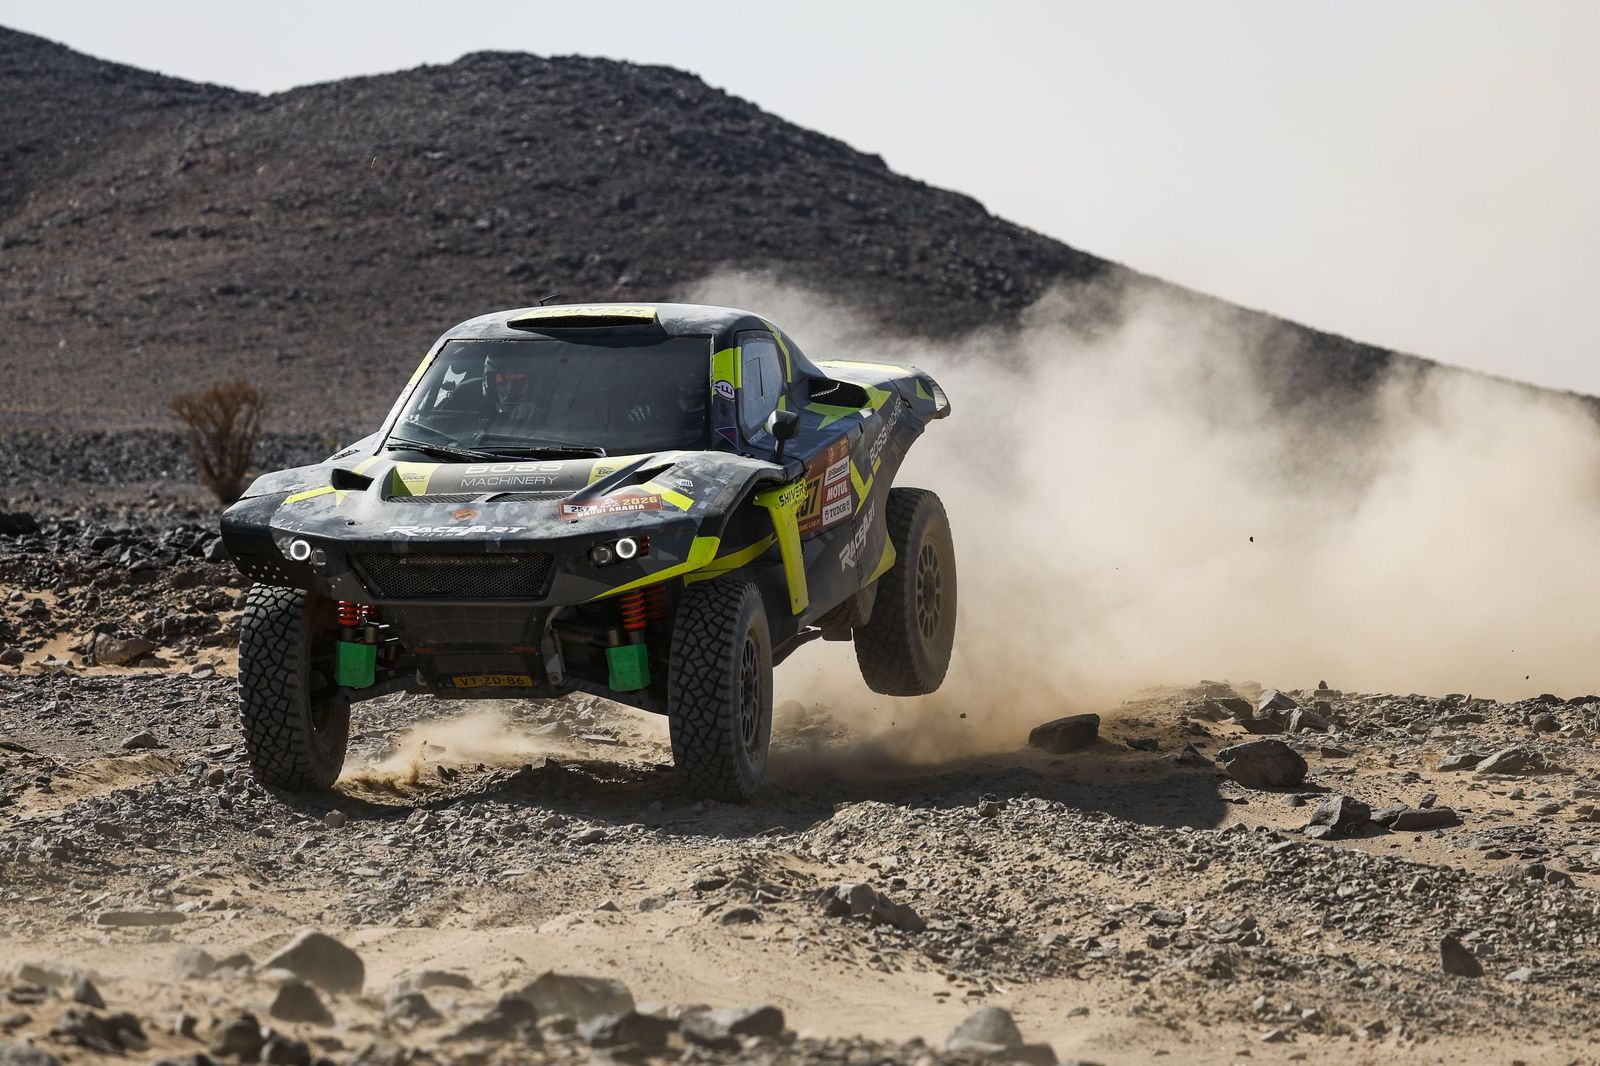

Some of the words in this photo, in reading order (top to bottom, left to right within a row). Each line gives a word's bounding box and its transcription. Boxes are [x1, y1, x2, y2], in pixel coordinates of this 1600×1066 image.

[465, 462, 564, 474] BOSS
[460, 476, 558, 488] MACHINERY
[826, 480, 849, 502] MOTUL
[622, 496, 659, 506] 2026
[577, 504, 607, 518] SAUDI
[609, 503, 646, 513] ARABIA
[829, 501, 848, 518] TUDOR
[459, 676, 525, 686] VT-ZD-86
